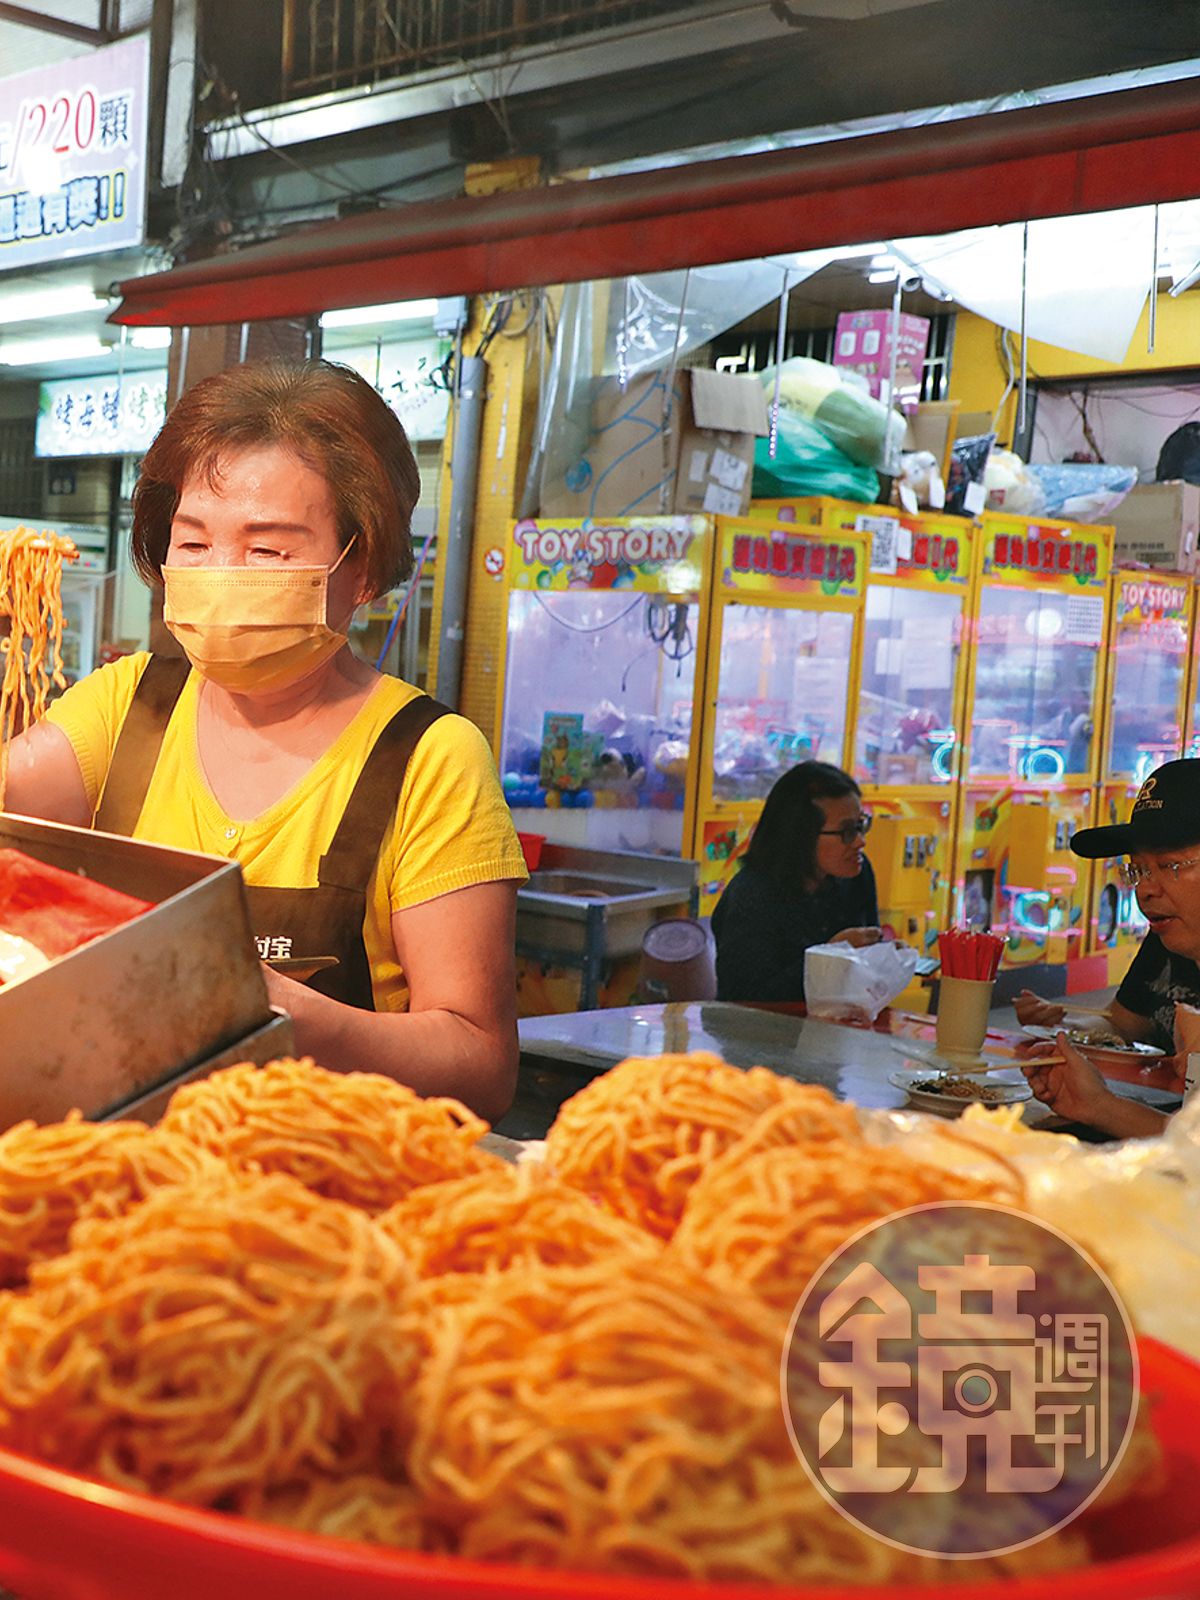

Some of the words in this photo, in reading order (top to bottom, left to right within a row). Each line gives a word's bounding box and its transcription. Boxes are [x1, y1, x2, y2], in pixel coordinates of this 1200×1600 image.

[520, 529, 582, 565] TOY
[588, 528, 692, 566] STORY
[1122, 582, 1146, 606] TOY
[1148, 585, 1186, 609] STORY
